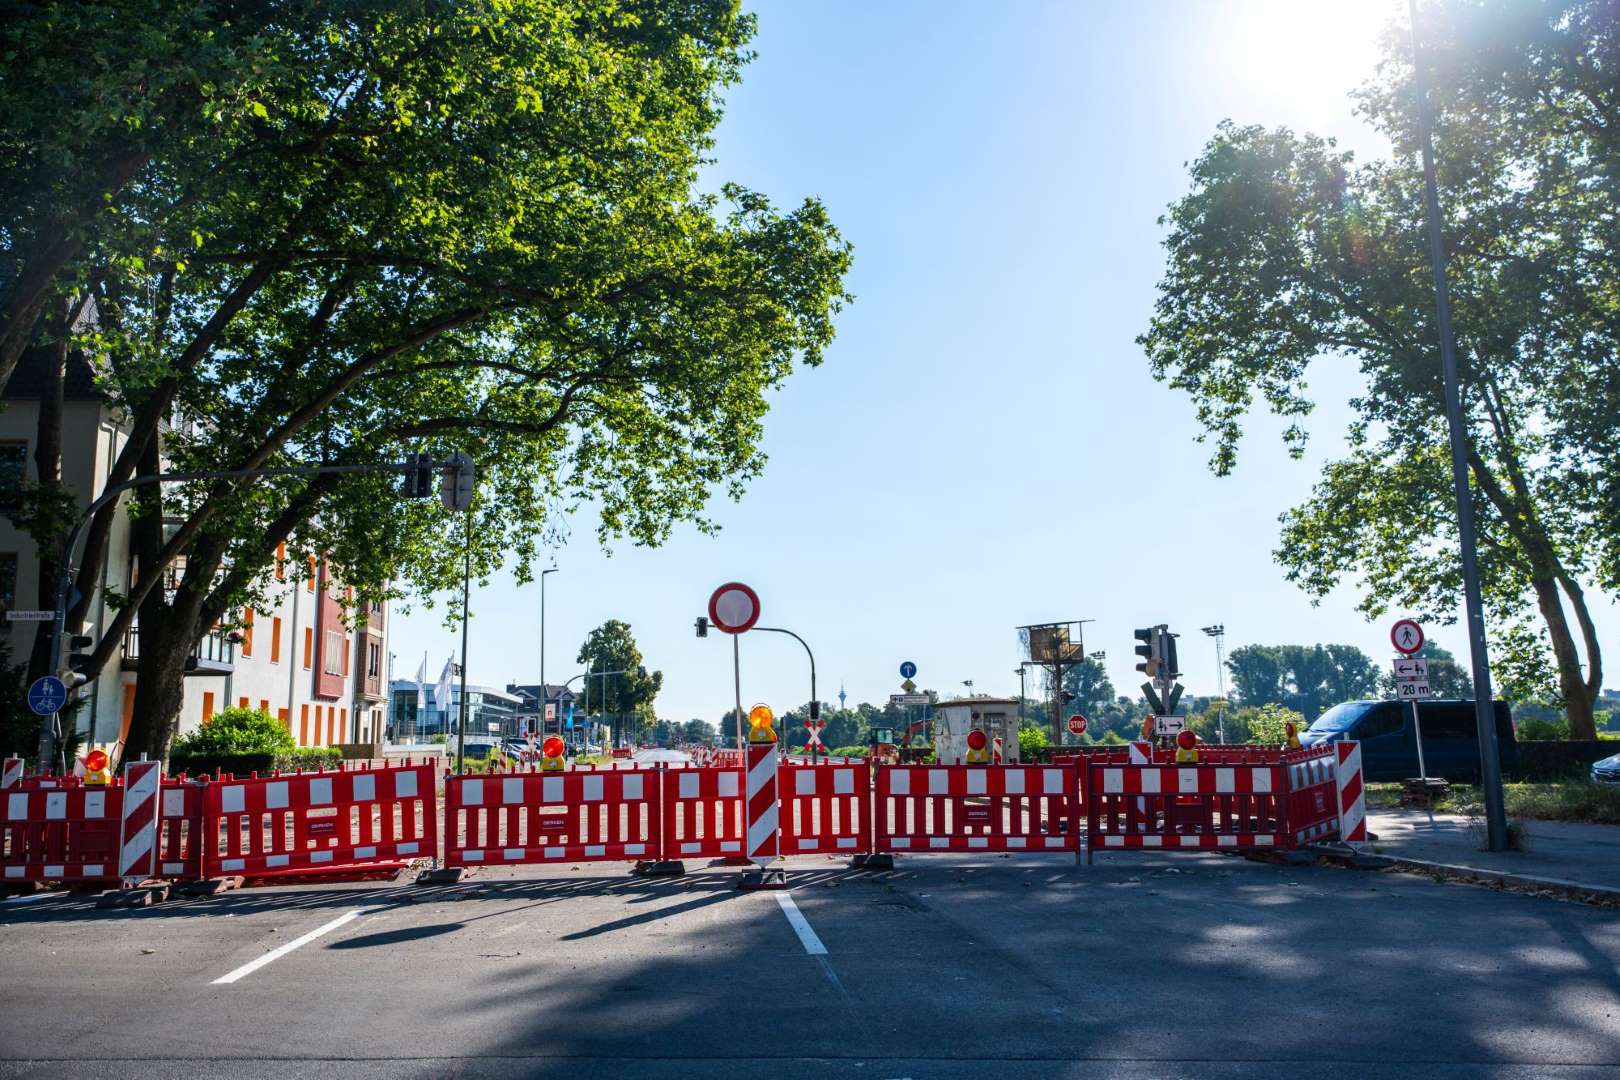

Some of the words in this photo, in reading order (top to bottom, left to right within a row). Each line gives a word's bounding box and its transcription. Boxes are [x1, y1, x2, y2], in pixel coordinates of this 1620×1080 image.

[1402, 684, 1415, 695] 20
[1418, 686, 1429, 694] m
[1070, 720, 1085, 729] STOP
